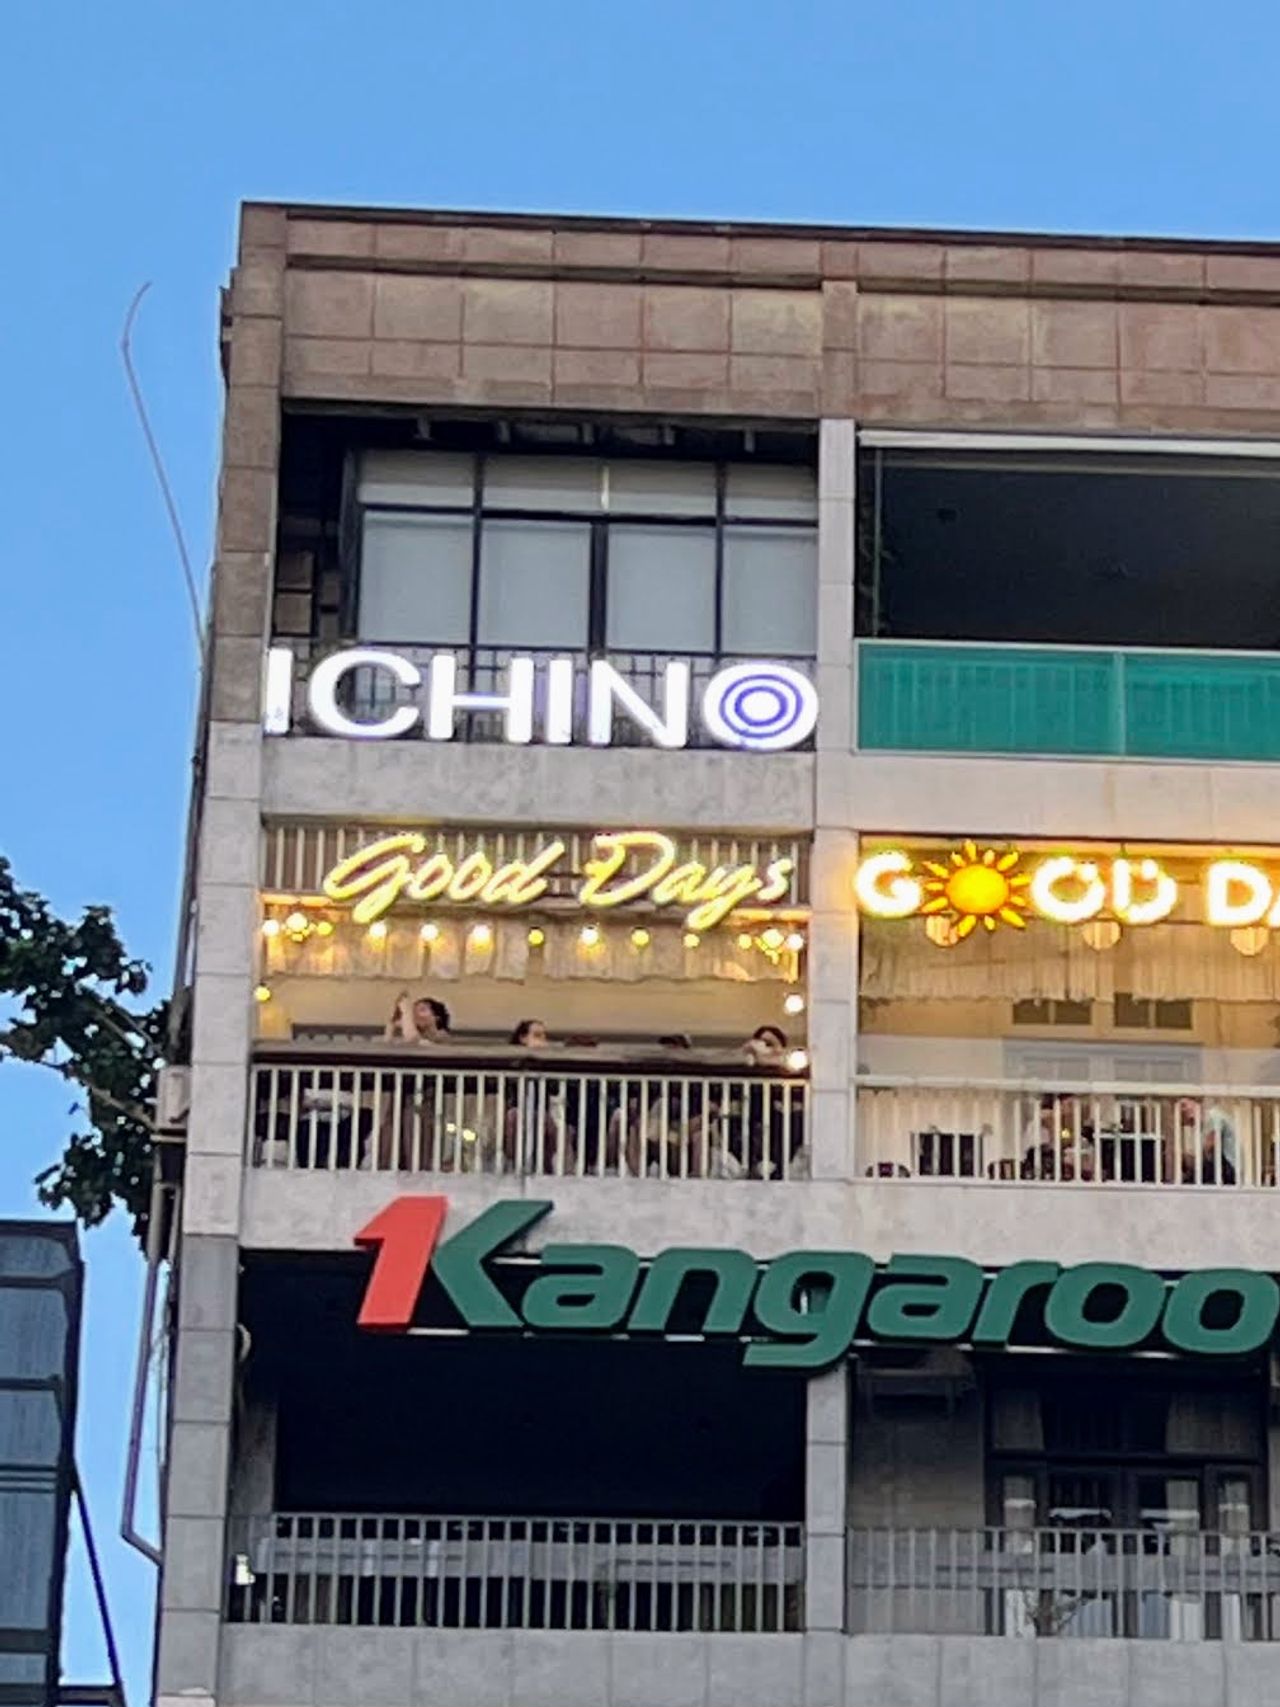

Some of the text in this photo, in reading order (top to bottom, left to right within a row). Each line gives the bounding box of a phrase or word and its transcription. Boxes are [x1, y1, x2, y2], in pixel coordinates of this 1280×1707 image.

[264, 645, 820, 752] ICHINO
[322, 830, 796, 927] Good Days
